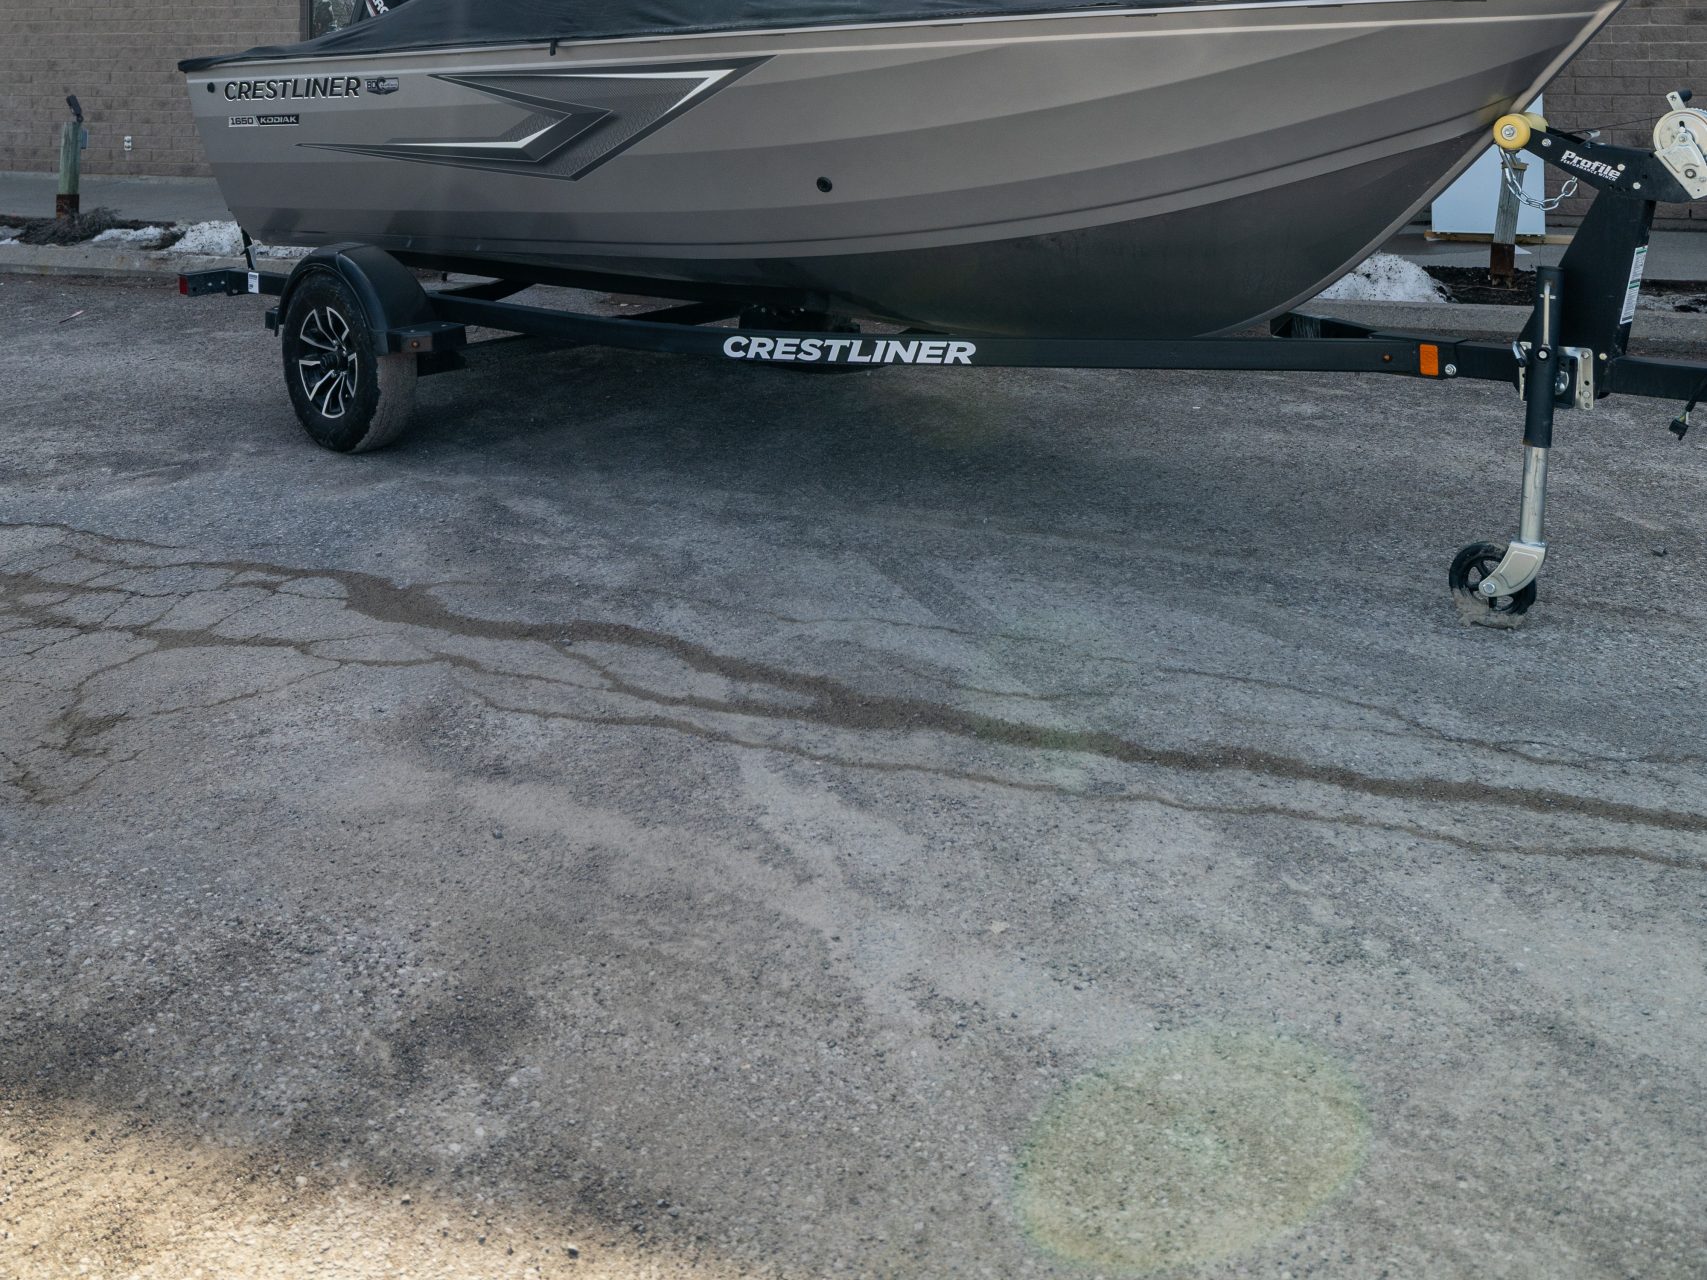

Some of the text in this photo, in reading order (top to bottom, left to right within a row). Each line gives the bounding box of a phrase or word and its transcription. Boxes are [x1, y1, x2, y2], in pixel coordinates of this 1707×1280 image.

[224, 76, 361, 102] CRESTLINER
[230, 114, 298, 126] 1650 KODIAK
[1561, 150, 1621, 178] Profile
[723, 335, 977, 365] CRESTLINER
